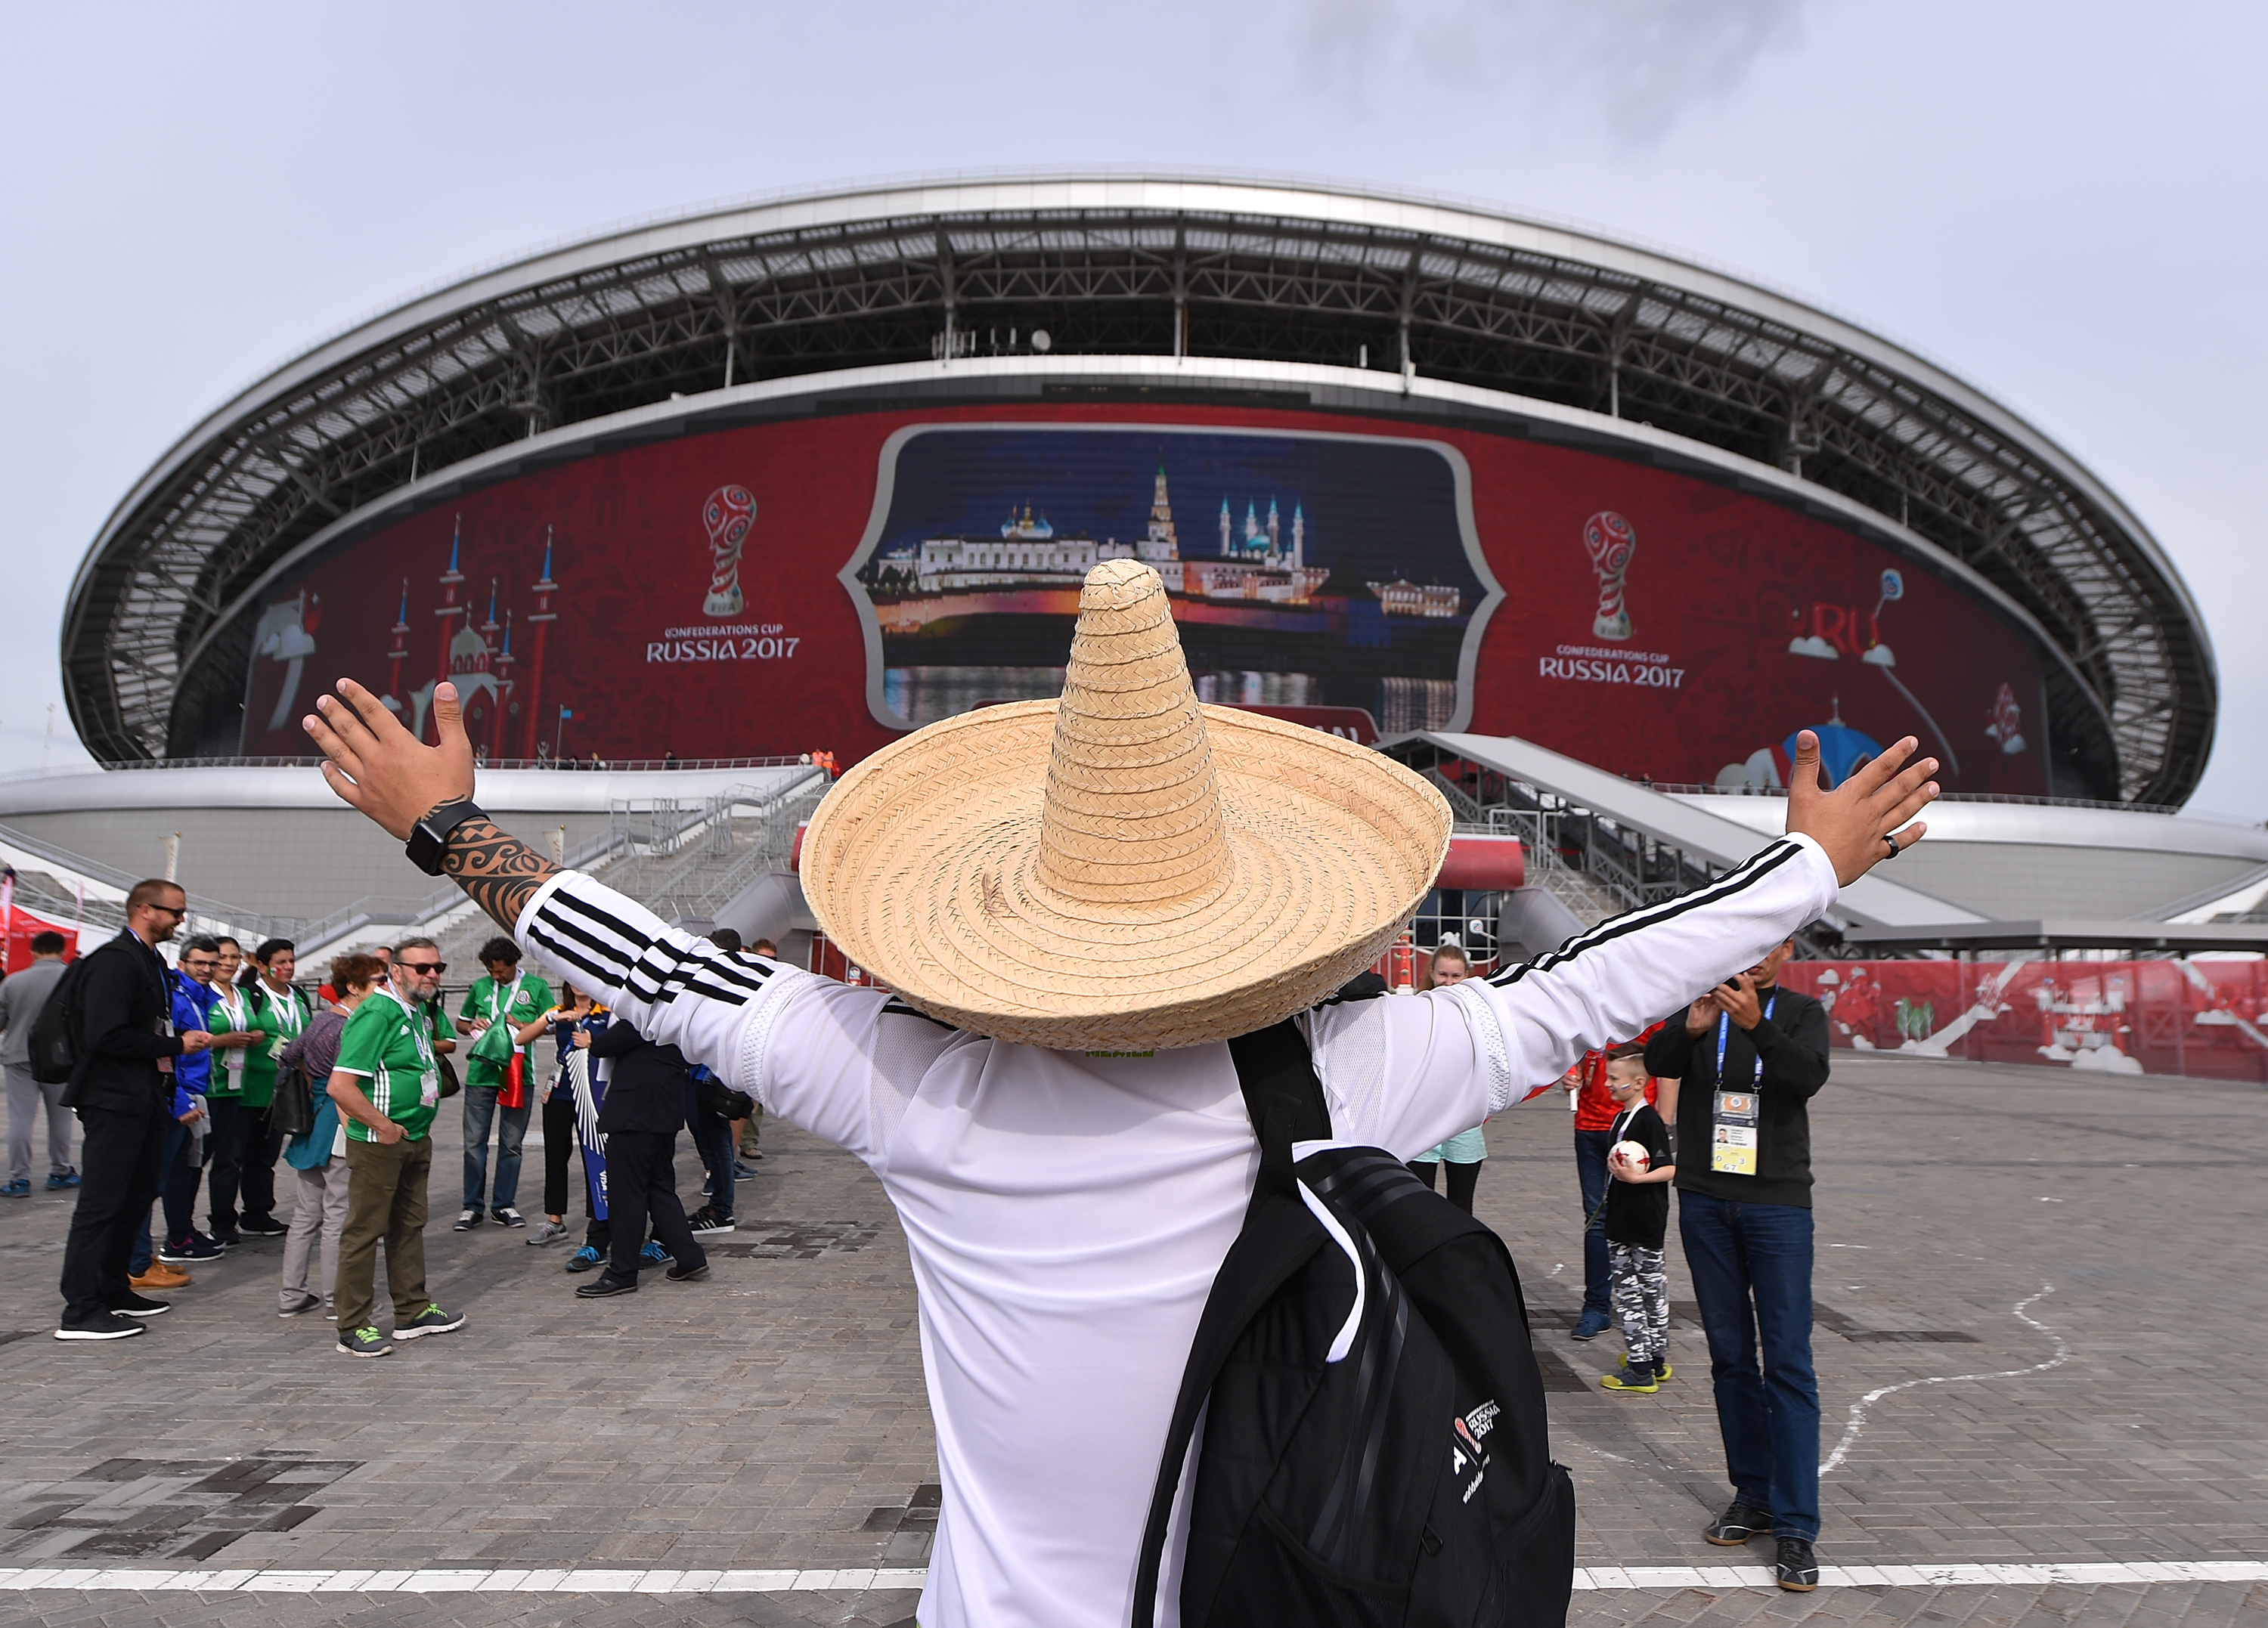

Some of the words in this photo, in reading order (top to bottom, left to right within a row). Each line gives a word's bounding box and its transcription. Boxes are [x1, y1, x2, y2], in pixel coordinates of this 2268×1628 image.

[665, 625, 758, 639] CONFEDERATIONS
[761, 624, 783, 635] CUP
[646, 639, 737, 664] RUSSIA
[741, 637, 800, 660] 2017
[1556, 644, 1648, 662] CONFEDERATIONS
[1649, 652, 1669, 664] CUP
[1539, 657, 1630, 684] RUSSIA
[1633, 664, 1685, 689] 2017
[1468, 1404, 1501, 1431] RUSSIA
[1474, 1418, 1494, 1441] 2017
